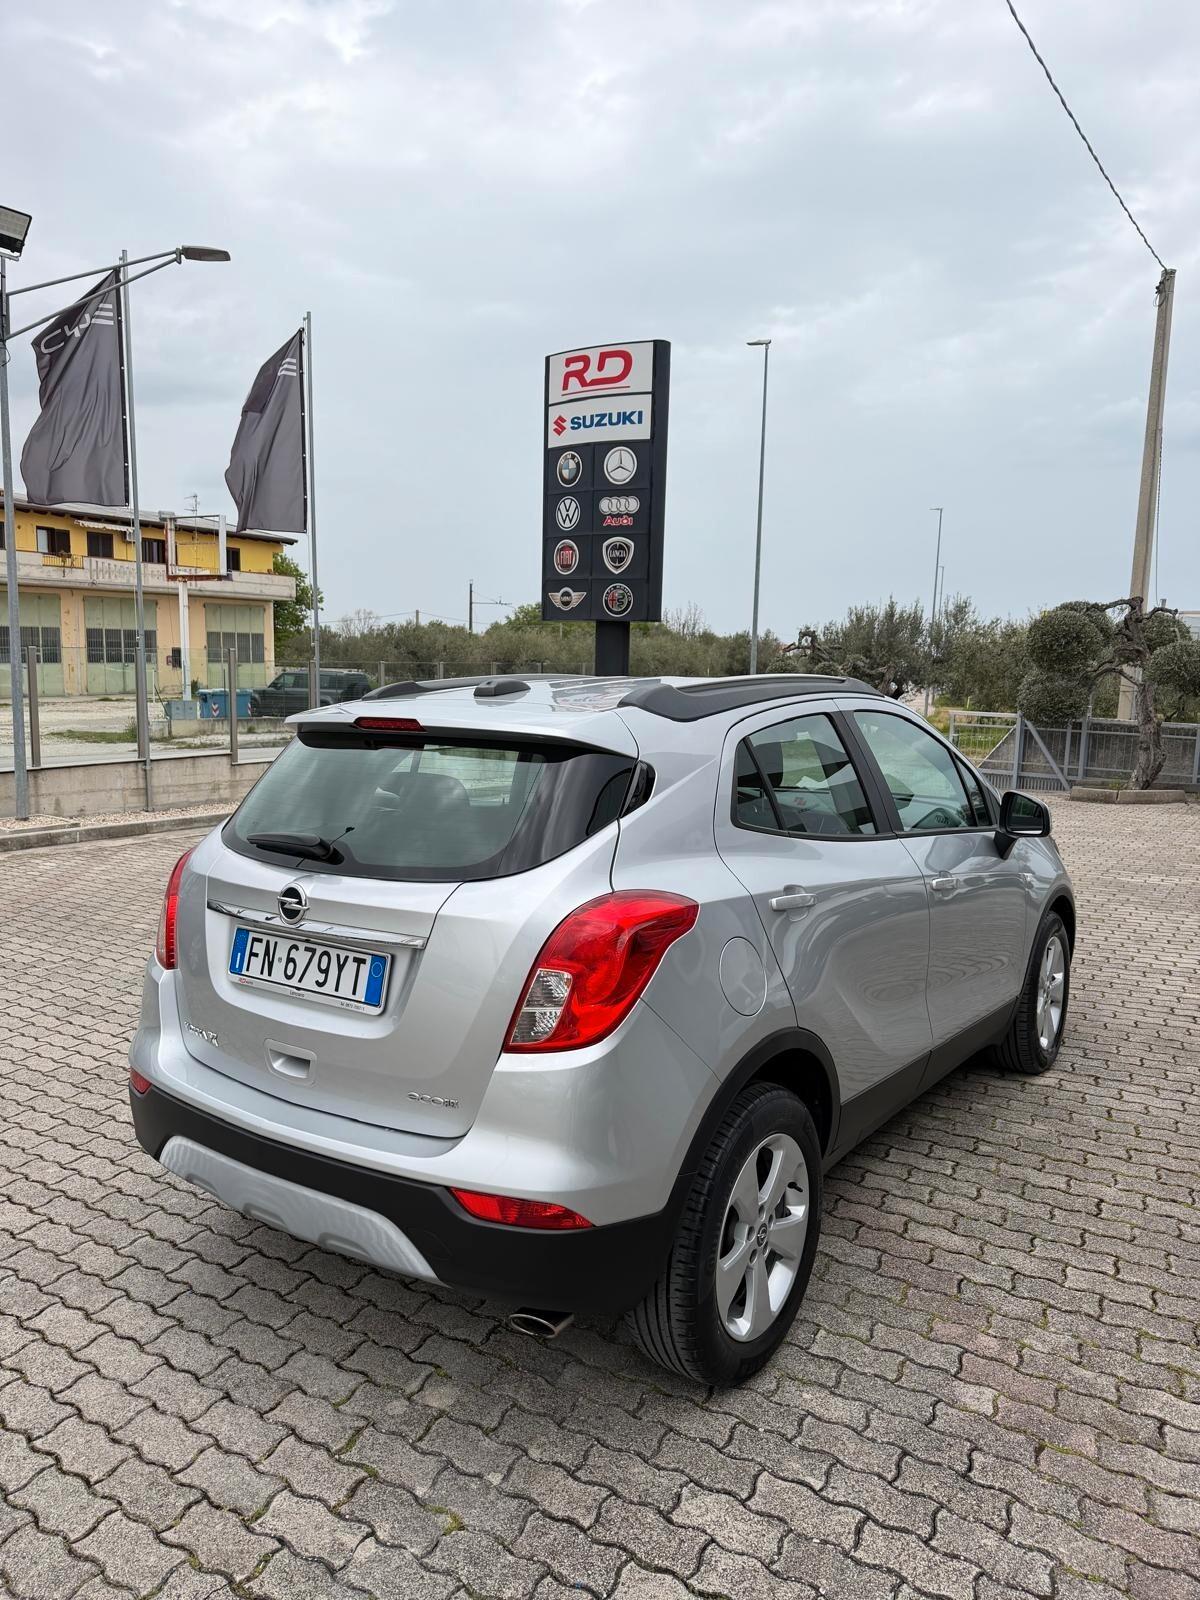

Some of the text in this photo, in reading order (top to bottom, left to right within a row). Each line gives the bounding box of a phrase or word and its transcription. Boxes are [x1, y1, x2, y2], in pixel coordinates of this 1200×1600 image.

[562, 349, 633, 391] RD
[570, 410, 643, 431] SUZUKI
[560, 550, 573, 565] FIAT
